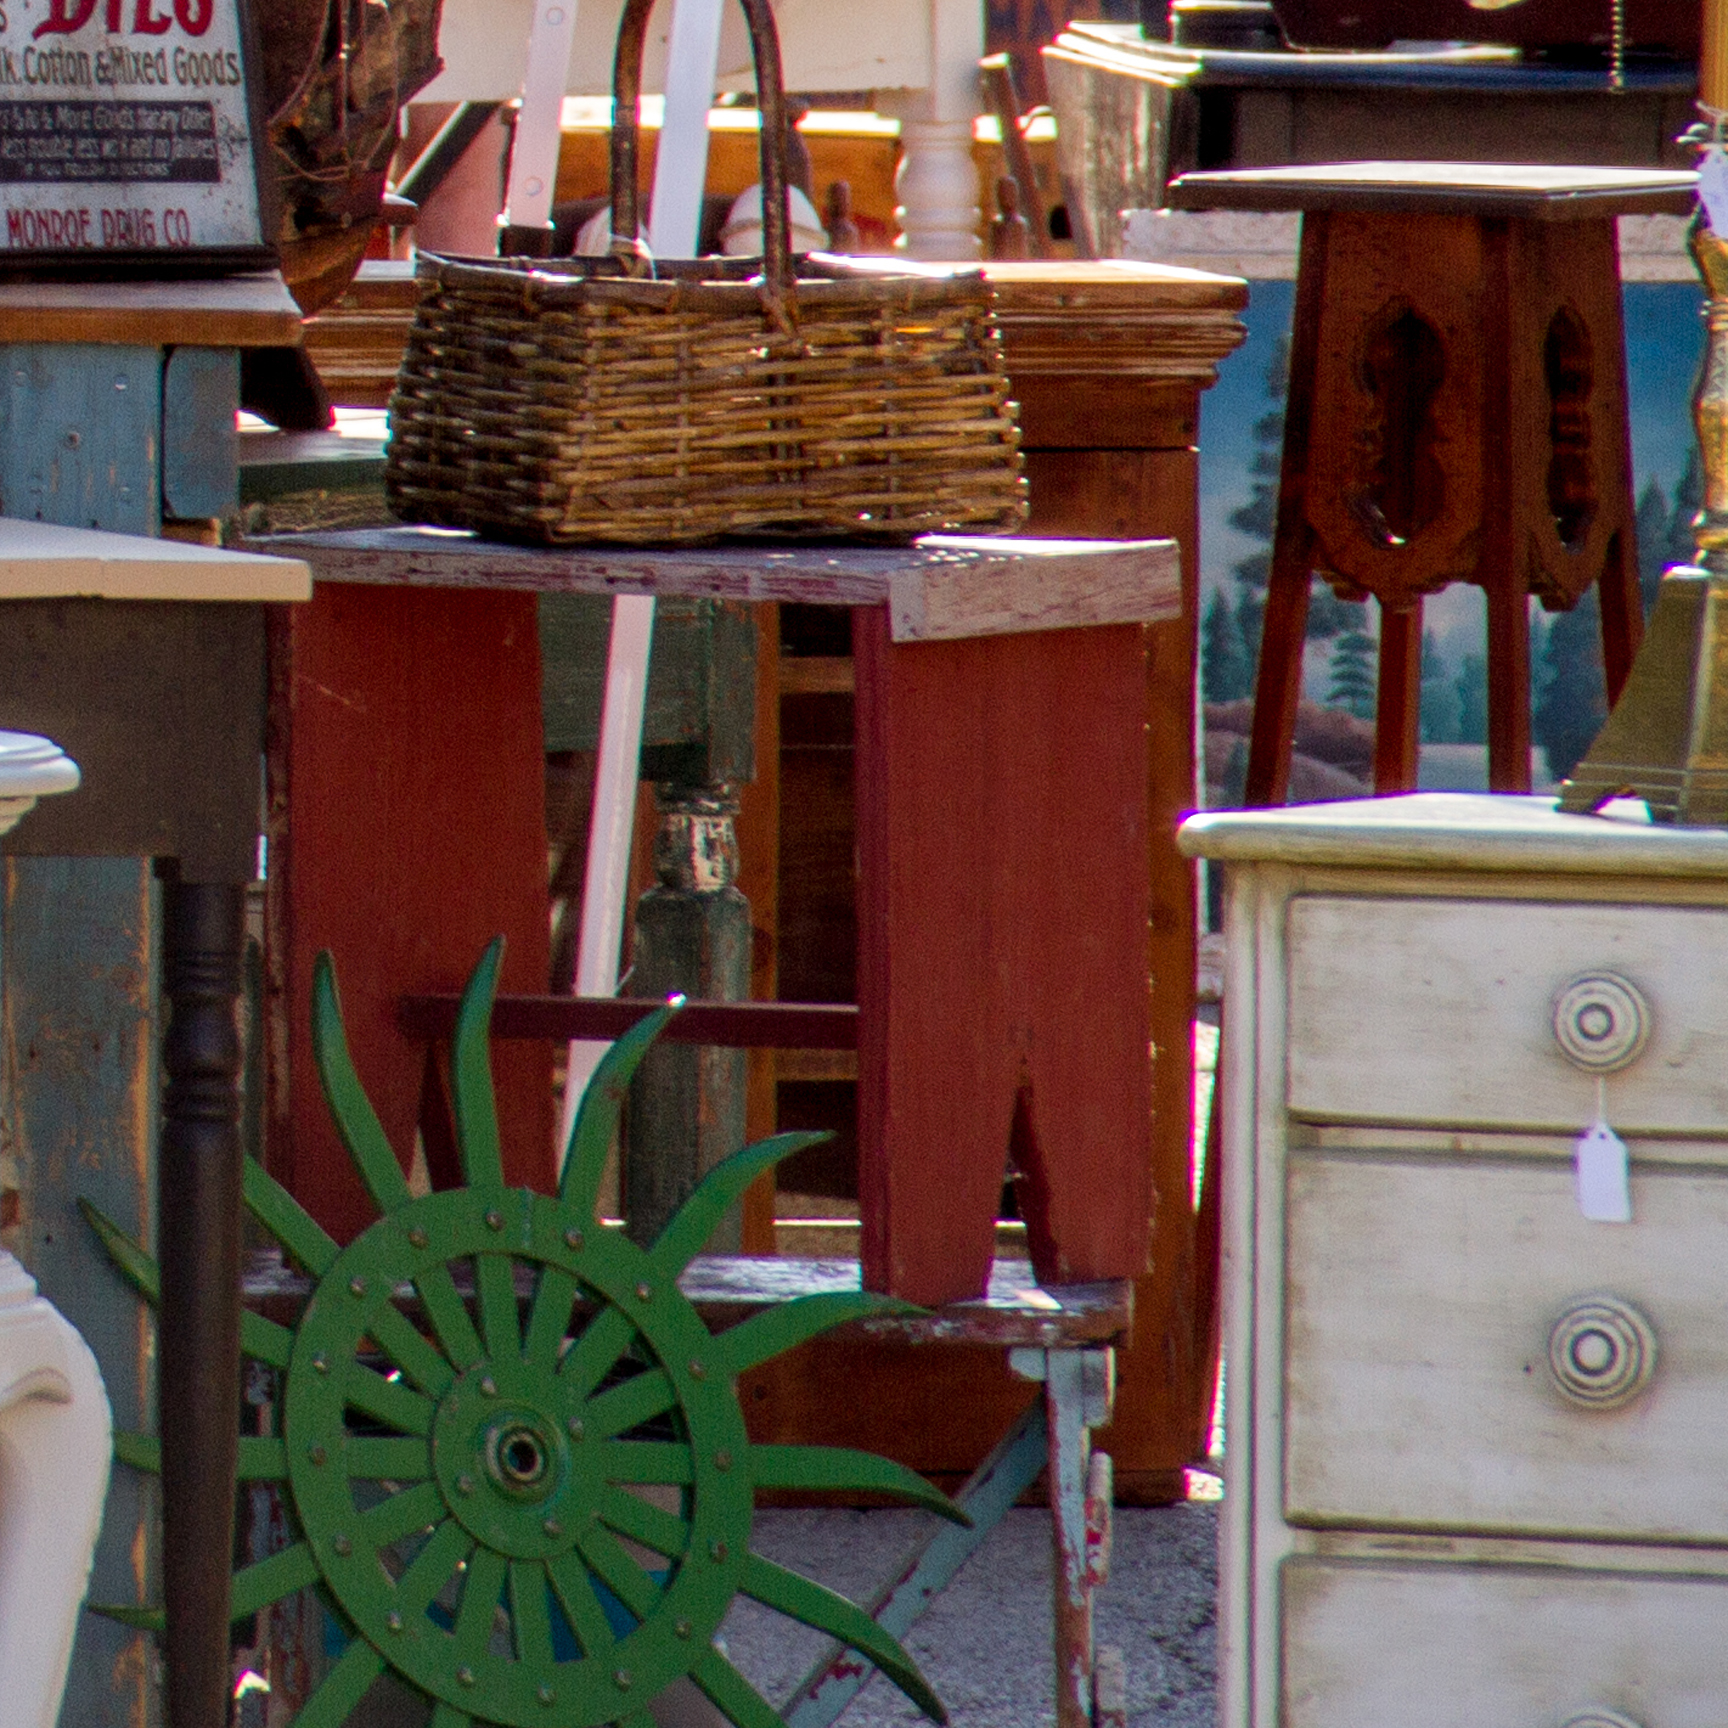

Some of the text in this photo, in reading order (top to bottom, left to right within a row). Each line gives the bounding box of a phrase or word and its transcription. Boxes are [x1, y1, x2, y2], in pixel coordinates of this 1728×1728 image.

[110, 45, 169, 85] Mixed
[174, 45, 241, 87] Goods
[6, 207, 93, 248] MONROE
[100, 208, 157, 248] DRUG
